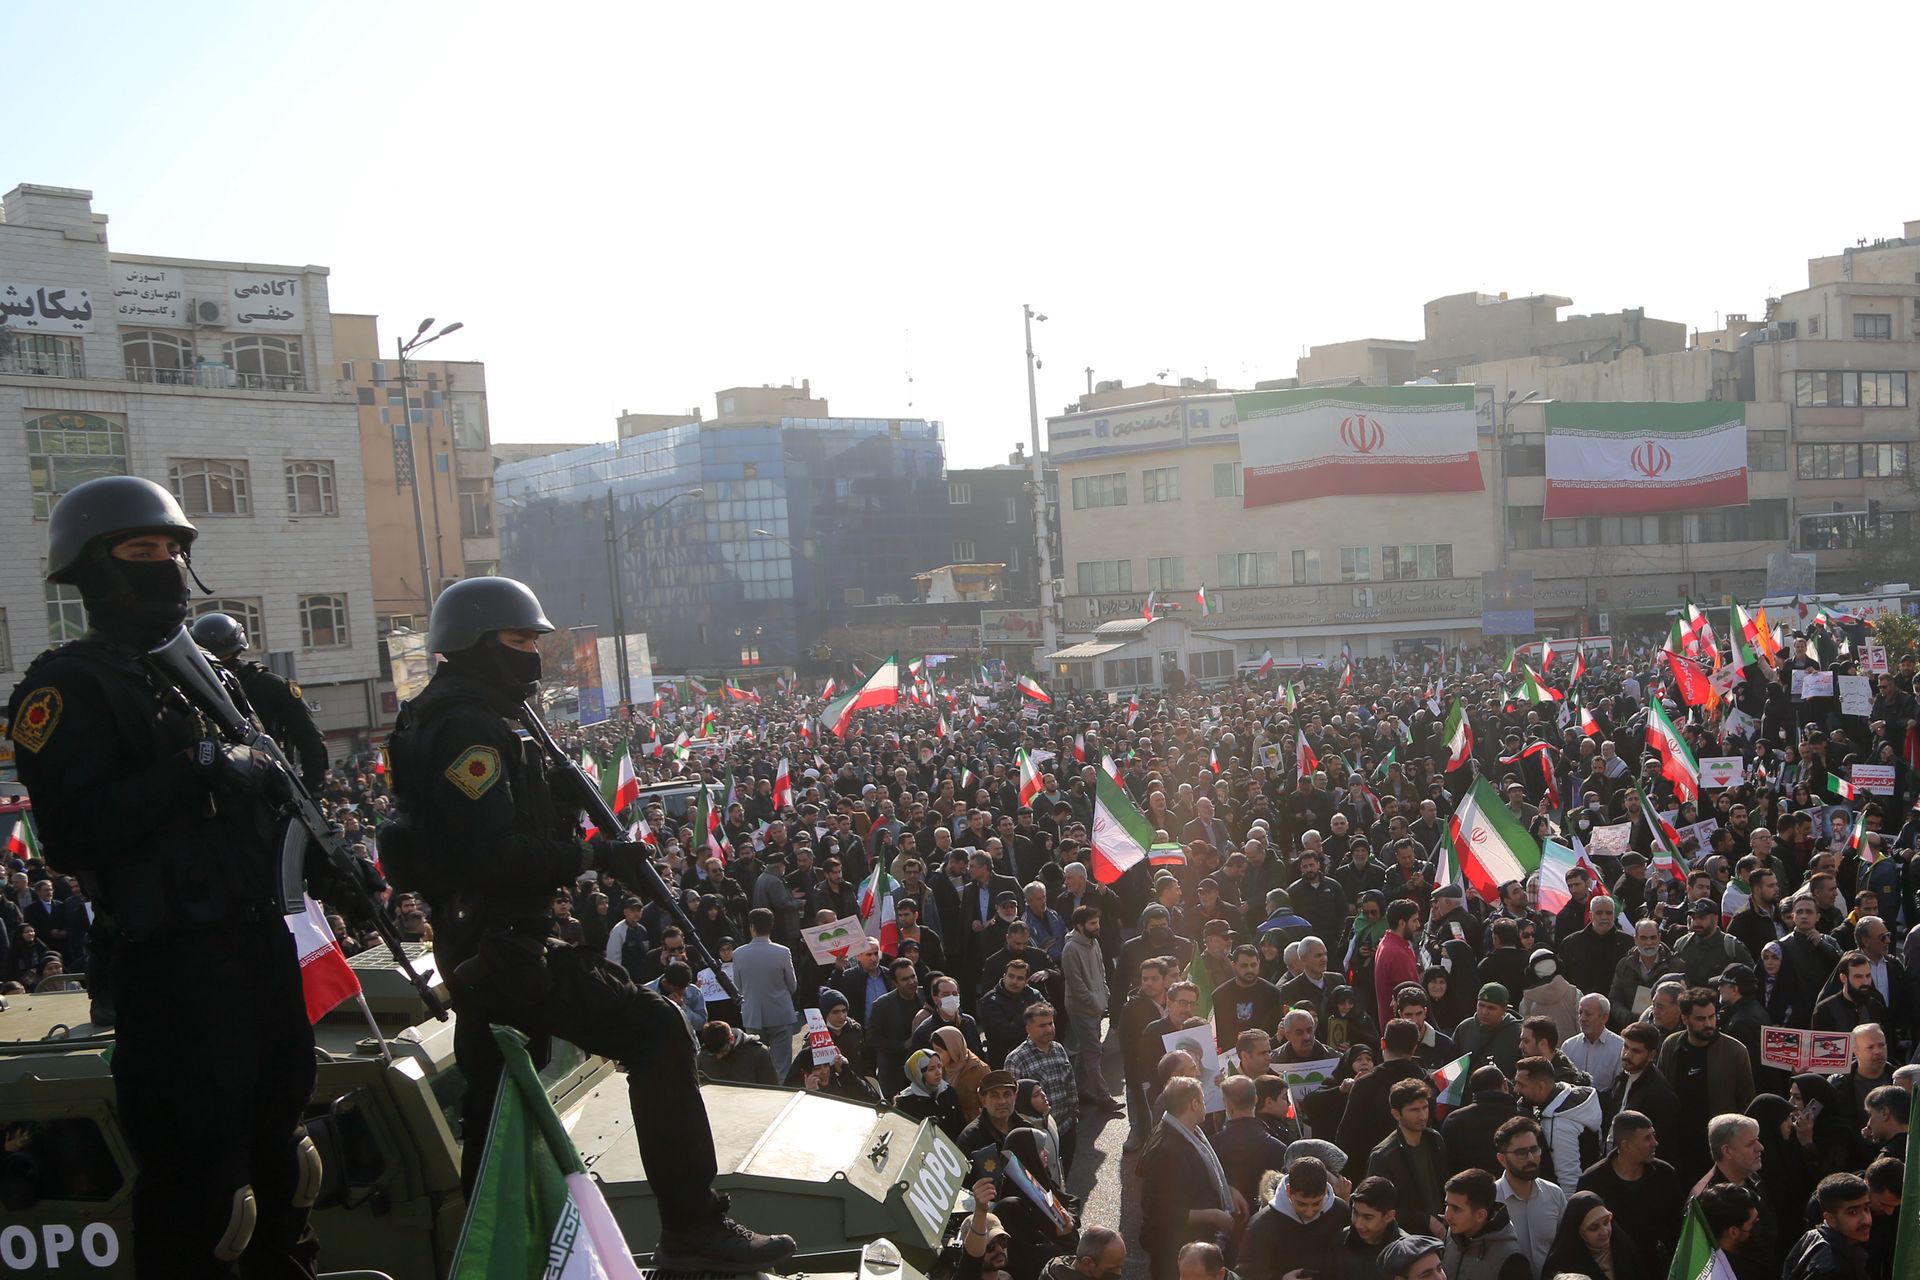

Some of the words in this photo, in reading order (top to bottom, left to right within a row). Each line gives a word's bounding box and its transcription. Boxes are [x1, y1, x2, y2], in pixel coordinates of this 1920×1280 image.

[126, 272, 165, 282] آموزش
[113, 288, 138, 298] دستی
[141, 289, 181, 301] الگوسازی
[234, 279, 297, 299] آکادمی
[118, 304, 168, 317] کامپیوتری
[169, 309, 176, 318] و
[236, 304, 294, 324] حنفی
[1377, 588, 1404, 606] ایران
[1406, 584, 1448, 601] صادرات
[1450, 579, 1479, 601] بانک
[909, 1137, 962, 1234] NOPO
